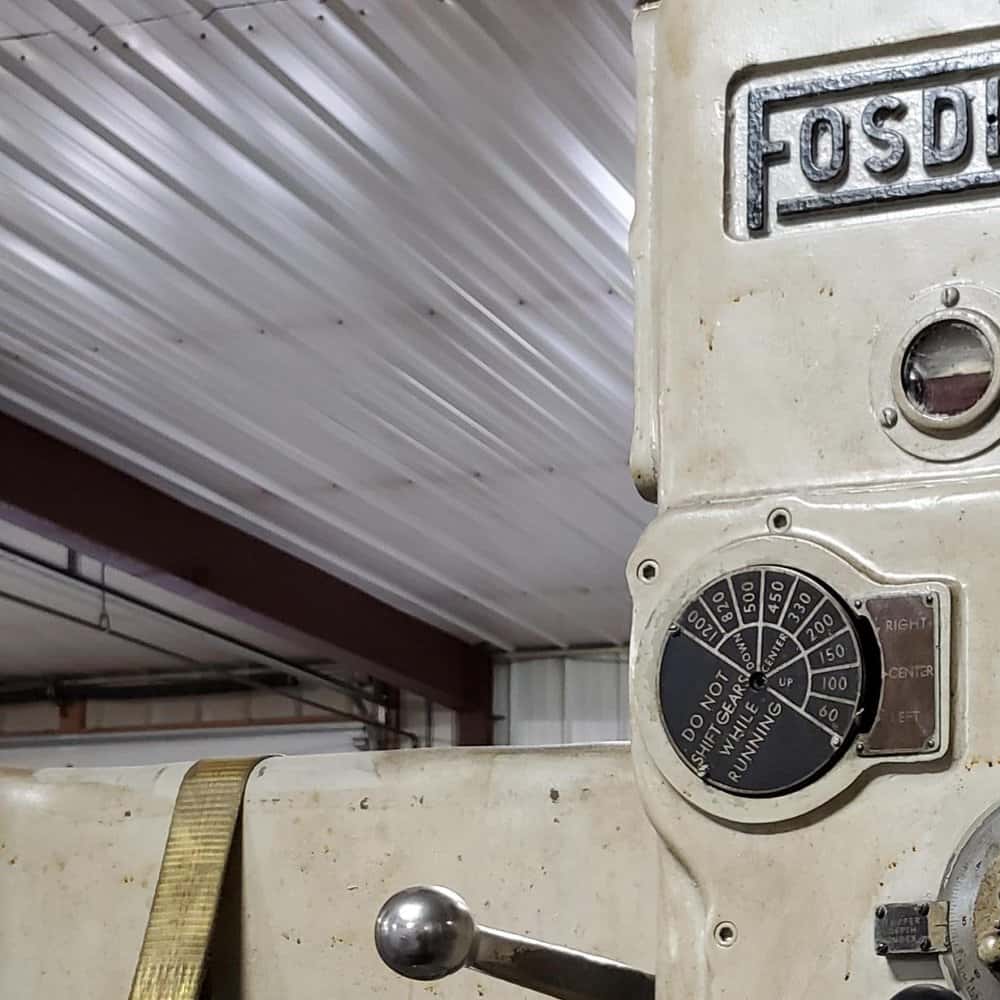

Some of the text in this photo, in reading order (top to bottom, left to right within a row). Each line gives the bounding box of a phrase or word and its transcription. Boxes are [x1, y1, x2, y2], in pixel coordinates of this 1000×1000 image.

[741, 581, 756, 613] 500
[768, 581, 784, 614] 450
[788, 592, 811, 623] 330
[687, 610, 718, 642] 1200
[806, 613, 834, 642] 200
[885, 617, 927, 632] RIGHT
[733, 633, 755, 670] DOWN
[761, 633, 788, 673] CENTER
[820, 643, 845, 664] 150
[779, 677, 794, 687] UP
[823, 676, 847, 690] 100
[888, 664, 934, 679] CENTER
[681, 669, 729, 742] DO NOT
[691, 674, 750, 766] SHIFT GEARS
[818, 704, 839, 722] 60
[719, 701, 759, 756] WHILE
[728, 701, 782, 783] RUNNING
